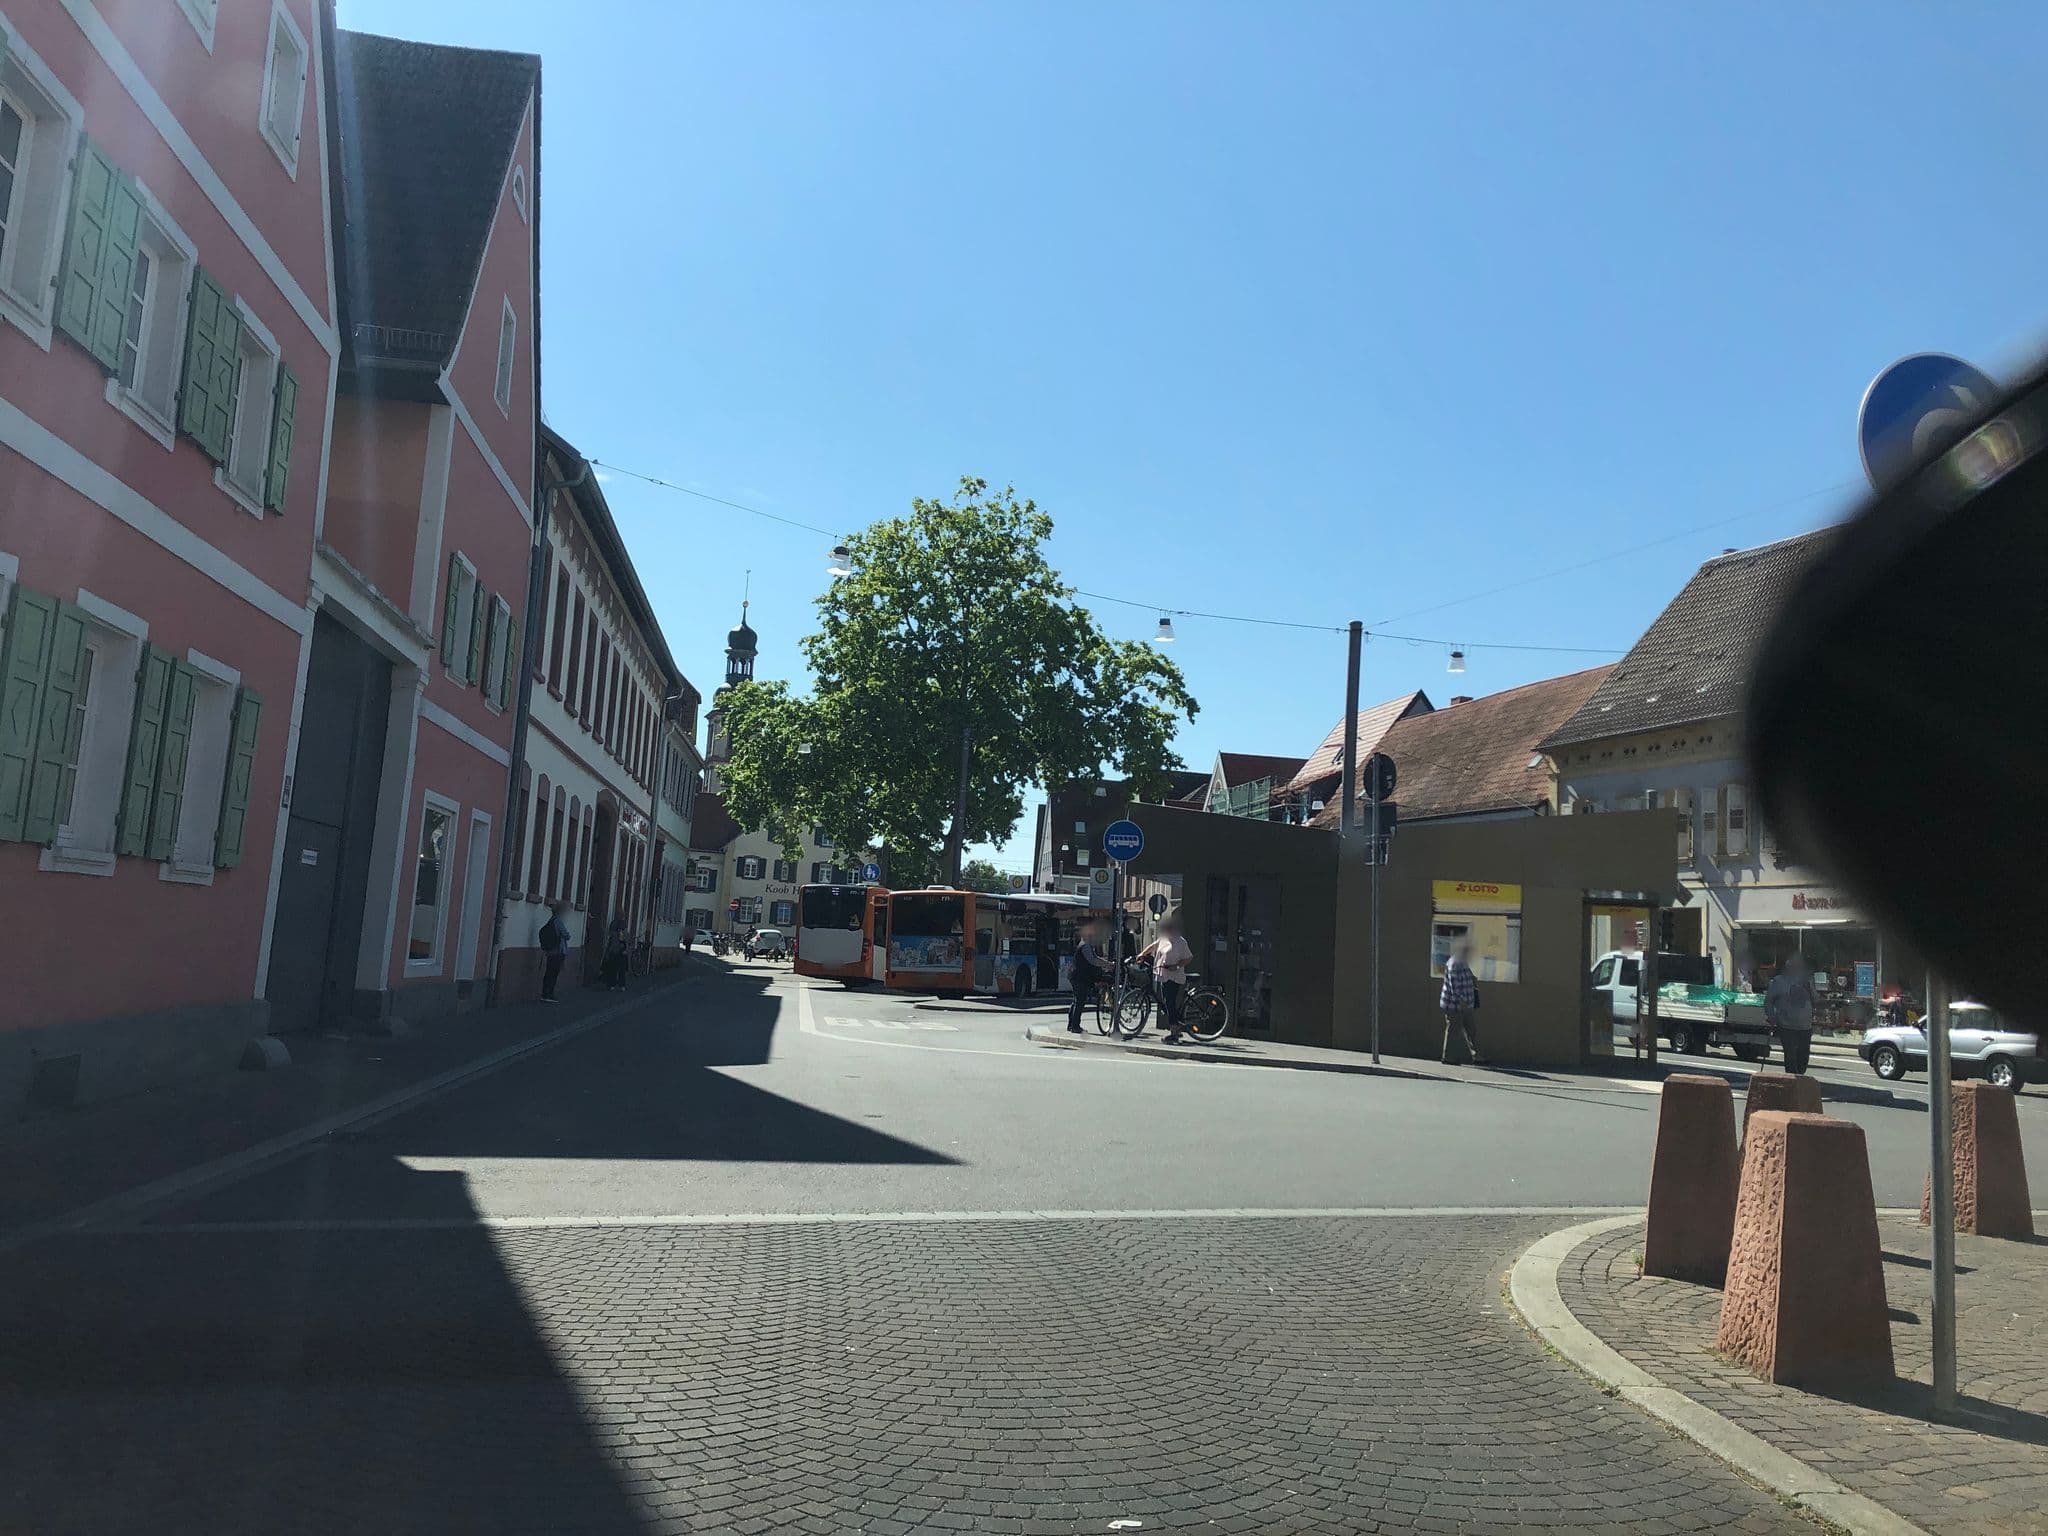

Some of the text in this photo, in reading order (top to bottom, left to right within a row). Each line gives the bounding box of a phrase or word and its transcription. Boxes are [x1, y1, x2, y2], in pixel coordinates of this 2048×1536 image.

[766, 884, 789, 894] Koob
[1469, 884, 1499, 894] LOTTO
[823, 1016, 959, 1030] BUS
